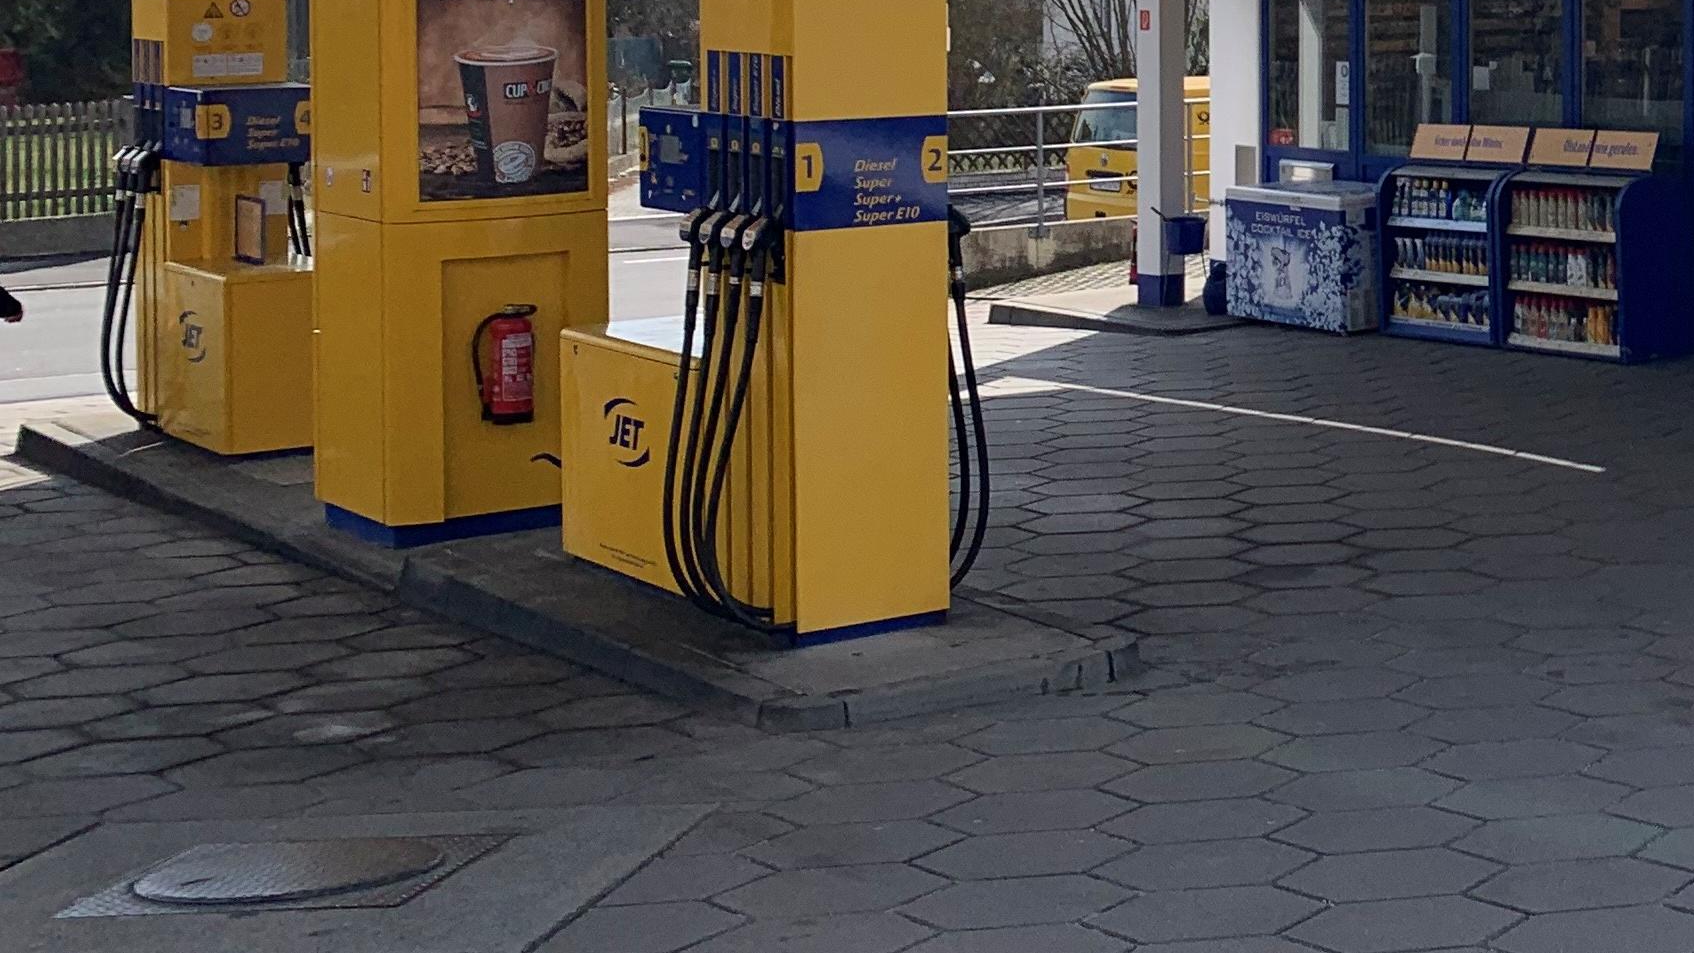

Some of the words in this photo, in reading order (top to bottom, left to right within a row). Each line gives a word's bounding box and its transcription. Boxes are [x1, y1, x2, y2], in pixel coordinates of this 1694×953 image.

[506, 83, 528, 98] CUP
[211, 113, 223, 131] 3
[801, 155, 813, 179] 1
[854, 157, 898, 172] Diesel
[928, 148, 942, 171] 2
[854, 176, 892, 192] Super
[854, 209, 894, 225] Super
[896, 206, 920, 219] E10
[609, 414, 645, 450] JET
